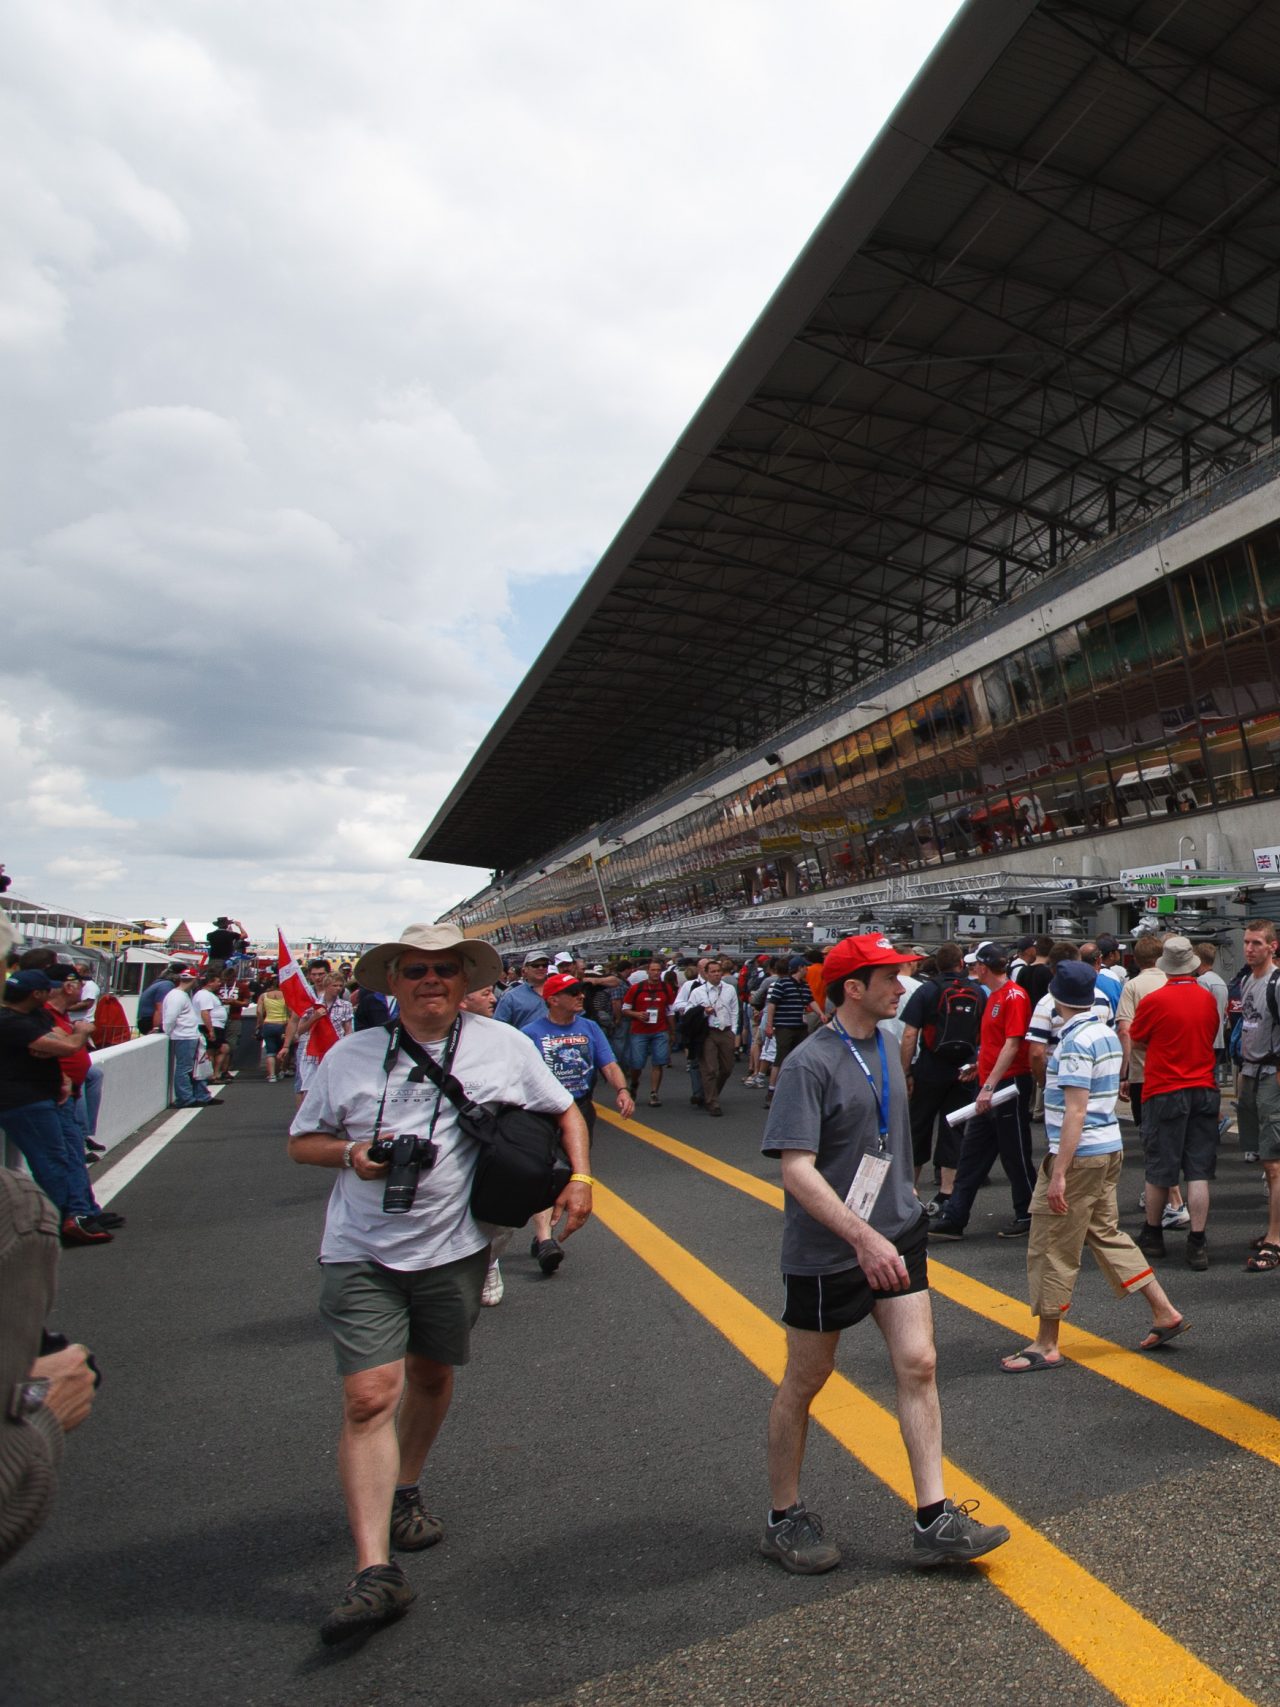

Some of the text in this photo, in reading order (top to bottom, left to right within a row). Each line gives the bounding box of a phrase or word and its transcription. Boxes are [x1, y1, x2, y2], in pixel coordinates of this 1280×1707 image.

[1146, 897, 1158, 909] 18
[968, 917, 976, 930] 4
[825, 928, 837, 939] 78
